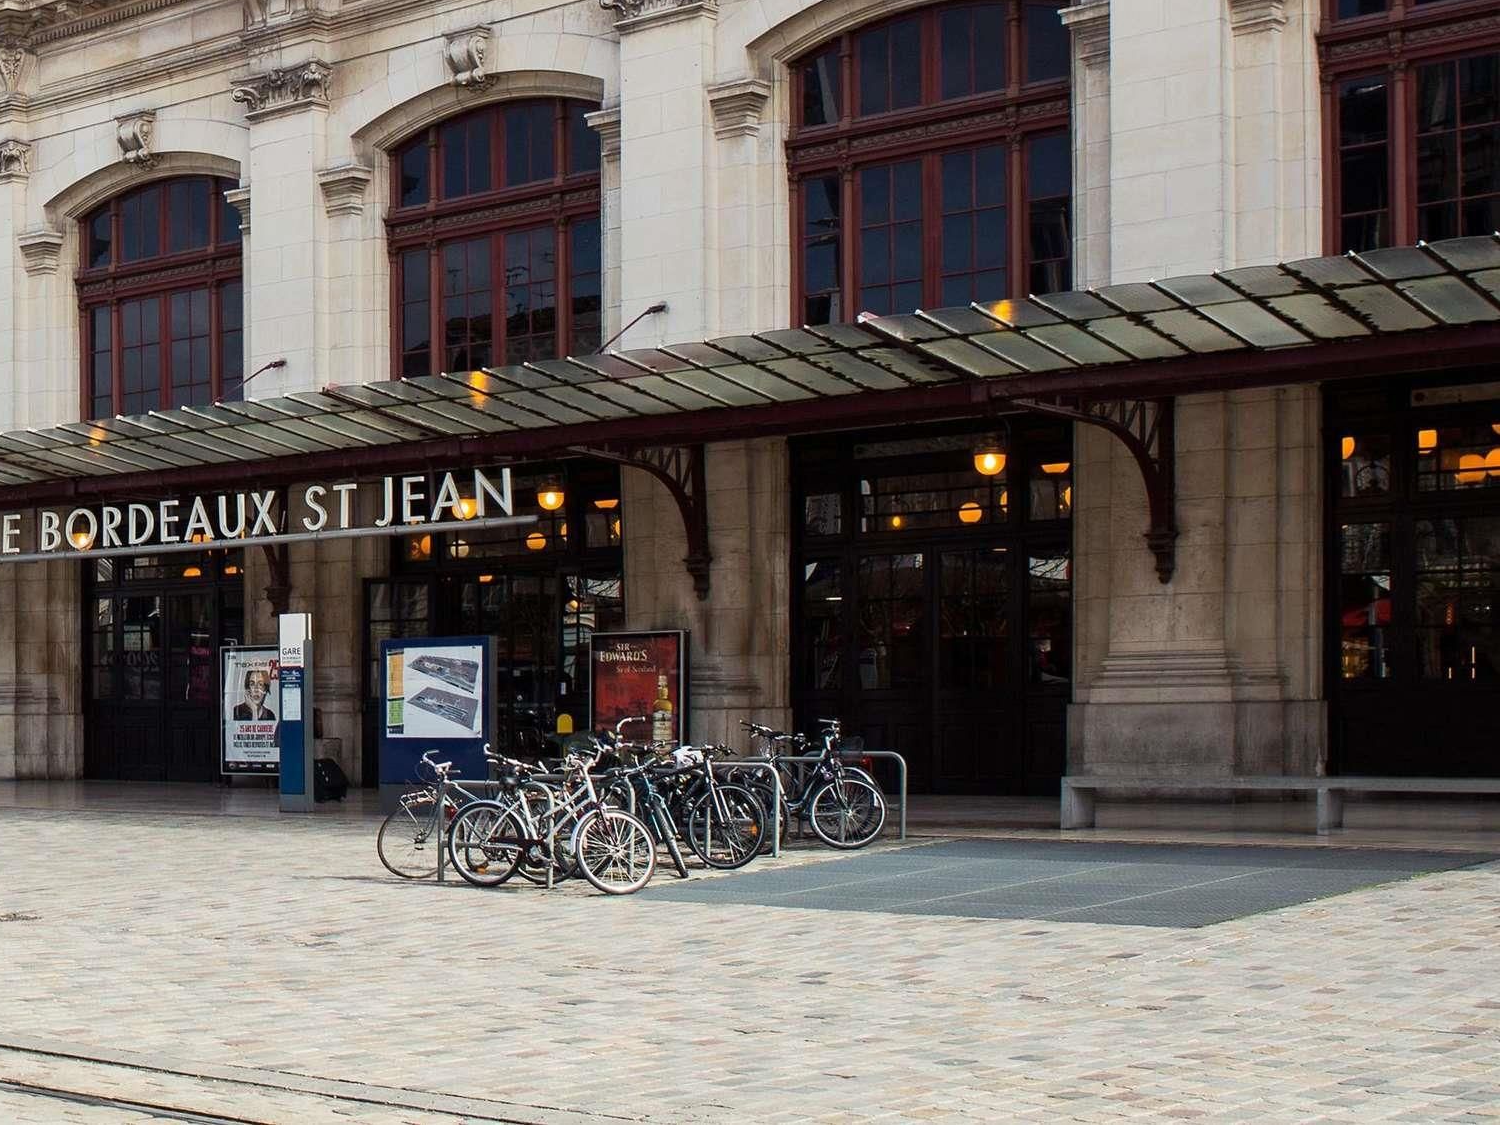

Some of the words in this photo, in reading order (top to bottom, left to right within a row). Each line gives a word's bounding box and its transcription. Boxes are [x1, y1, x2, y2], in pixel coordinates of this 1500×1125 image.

[41, 490, 277, 552] BORDEAUX
[302, 483, 358, 531] ST
[374, 467, 514, 528] JEAN
[282, 647, 301, 656] GARE
[616, 643, 630, 651] SIR
